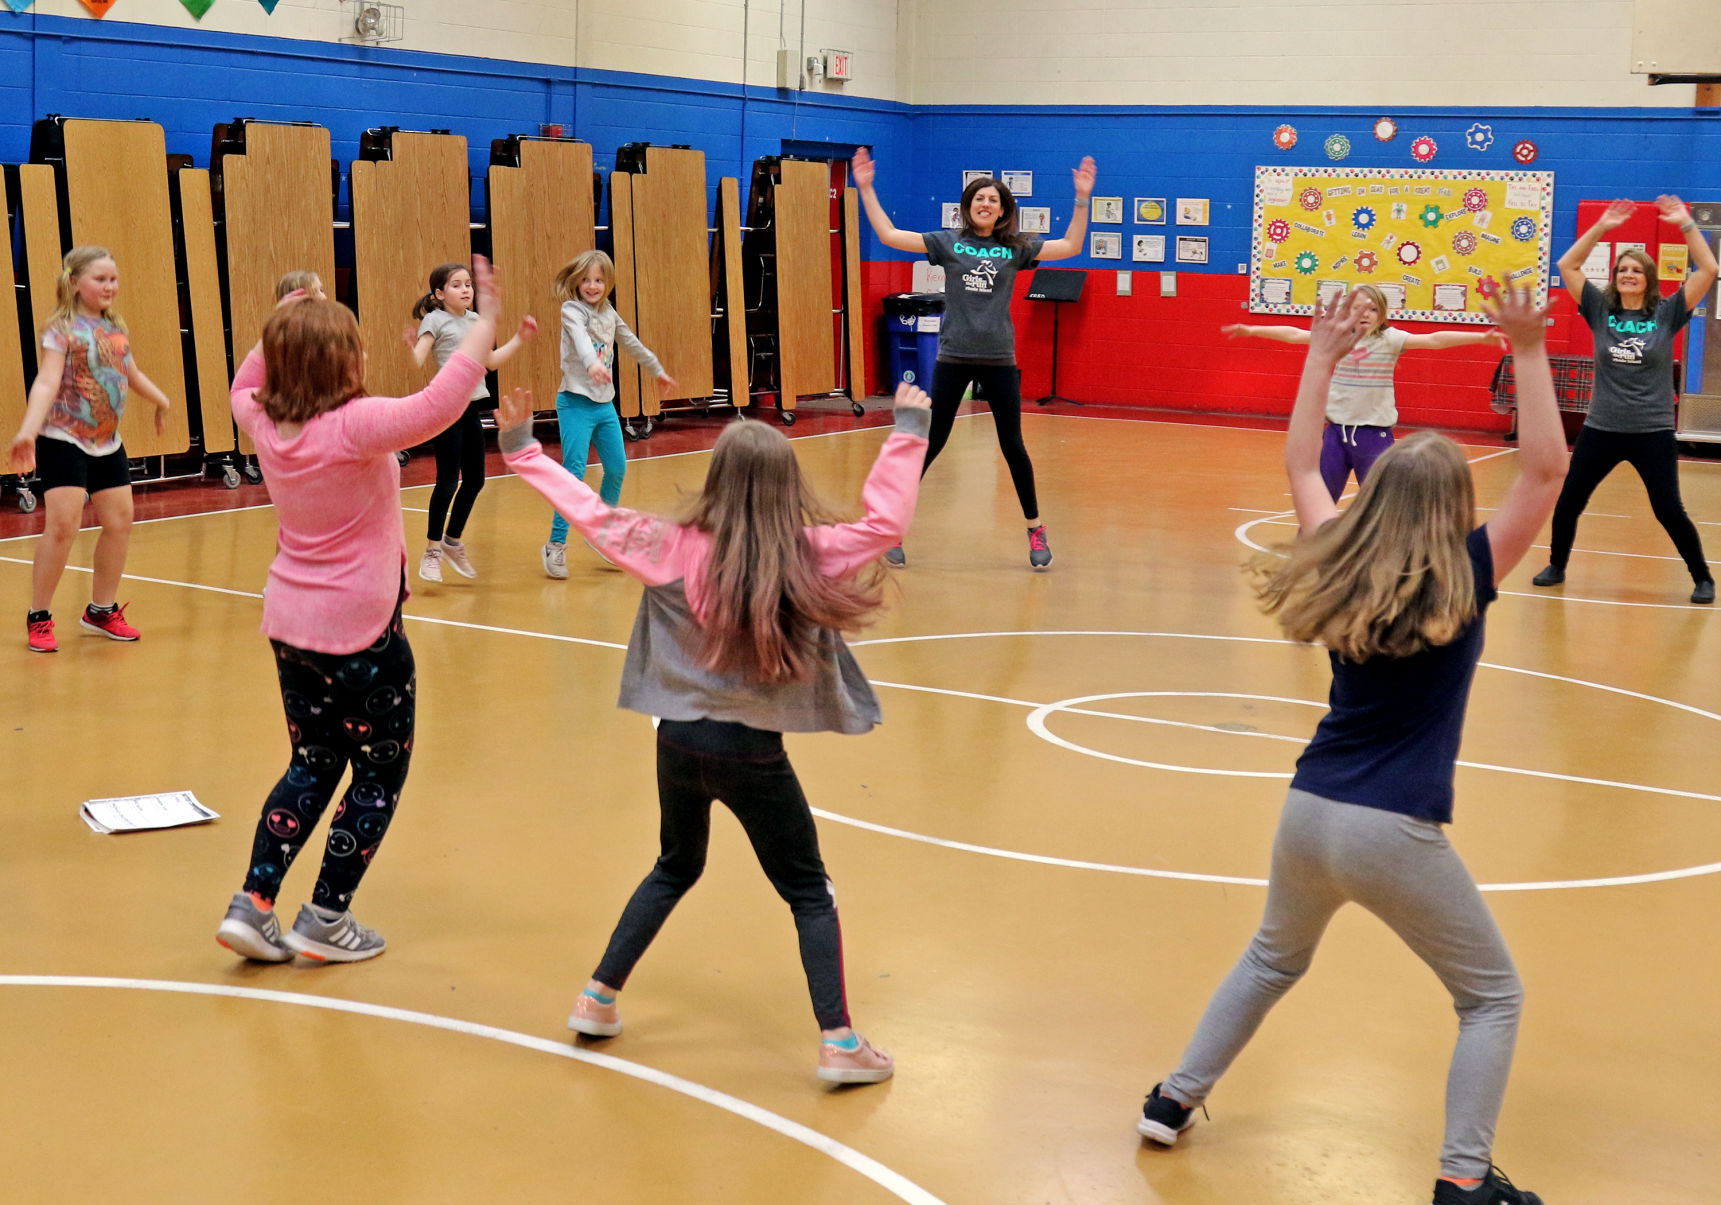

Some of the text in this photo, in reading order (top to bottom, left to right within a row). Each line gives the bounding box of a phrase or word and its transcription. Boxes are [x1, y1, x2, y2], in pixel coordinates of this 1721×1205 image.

[1294, 222, 1325, 237] COLLABORATE
[953, 242, 1013, 259] COACH
[1468, 266, 1483, 275] BUILD
[1509, 267, 1534, 280] HALLENGE
[1402, 274, 1422, 286] CREATE
